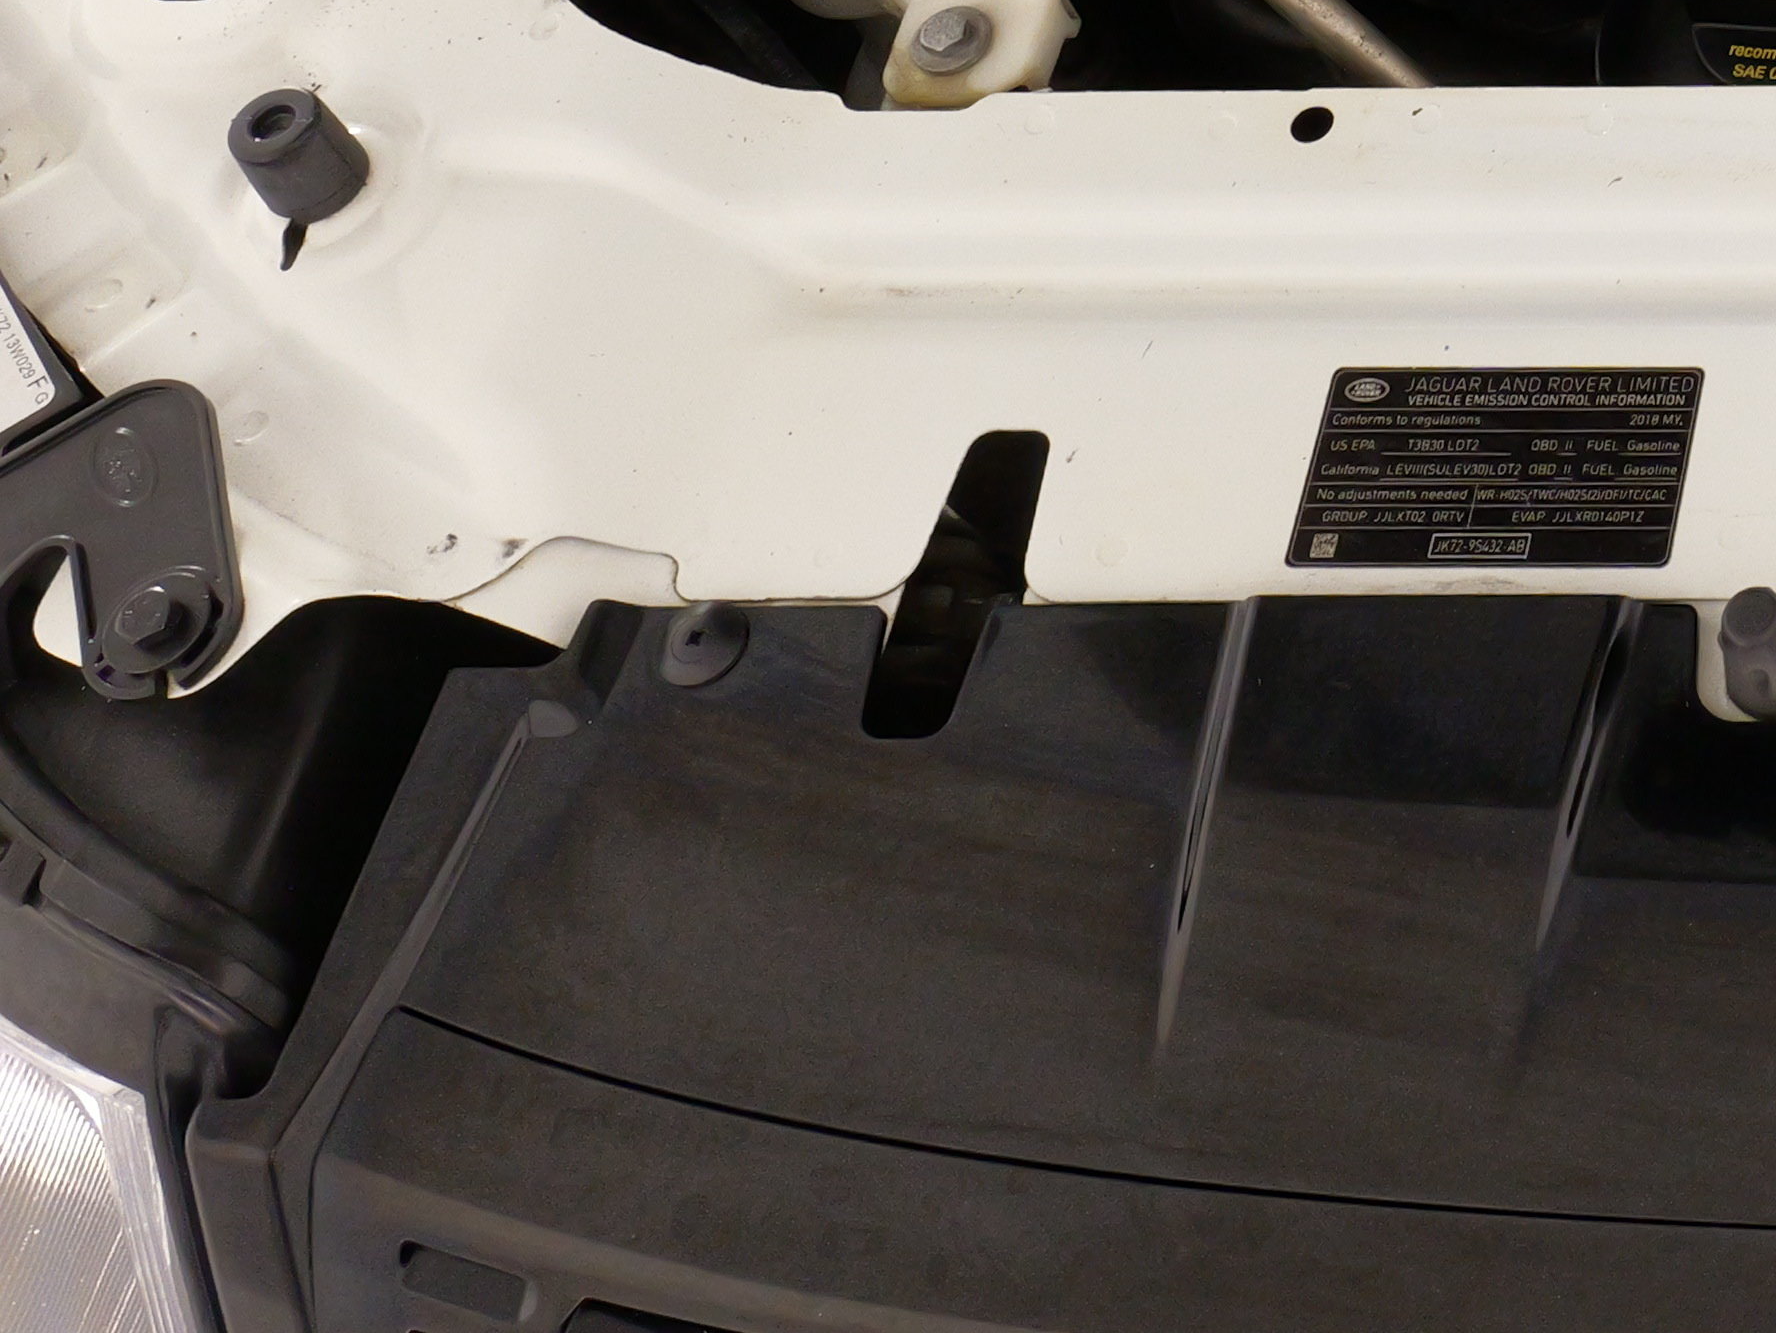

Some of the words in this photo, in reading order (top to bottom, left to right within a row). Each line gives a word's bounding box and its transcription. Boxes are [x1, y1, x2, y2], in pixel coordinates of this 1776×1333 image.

[1732, 63, 1767, 80] SAE
[6, 333, 37, 380] 13W029
[1405, 376, 1482, 393] JAGUAR
[1487, 376, 1542, 393] LAND
[1547, 376, 1613, 393] ROVER
[1616, 376, 1695, 393] LIMITED
[1408, 394, 1462, 406] VEHICLE
[1465, 394, 1528, 406] EMISSION
[1531, 394, 1591, 406] CONTROL
[1595, 394, 1686, 406] INFORMATION
[1332, 413, 1393, 426] Conforms
[1396, 413, 1407, 426] to
[1411, 413, 1481, 428] regulations
[1629, 414, 1659, 426] 2018
[1330, 439, 1350, 451] US
[1351, 439, 1377, 451] EPA
[1531, 439, 1558, 451] OBD
[1586, 439, 1619, 451] FUEL
[1627, 438, 1681, 451] Gasoline
[1320, 463, 1380, 476] California
[1528, 463, 1557, 476] OBD
[1582, 463, 1616, 476] FUEL
[1623, 463, 1678, 476] Gasoline
[1316, 488, 1336, 500] No
[1338, 488, 1418, 502] adjustments
[1420, 488, 1469, 501] needed
[1511, 510, 1547, 523] EVAP
